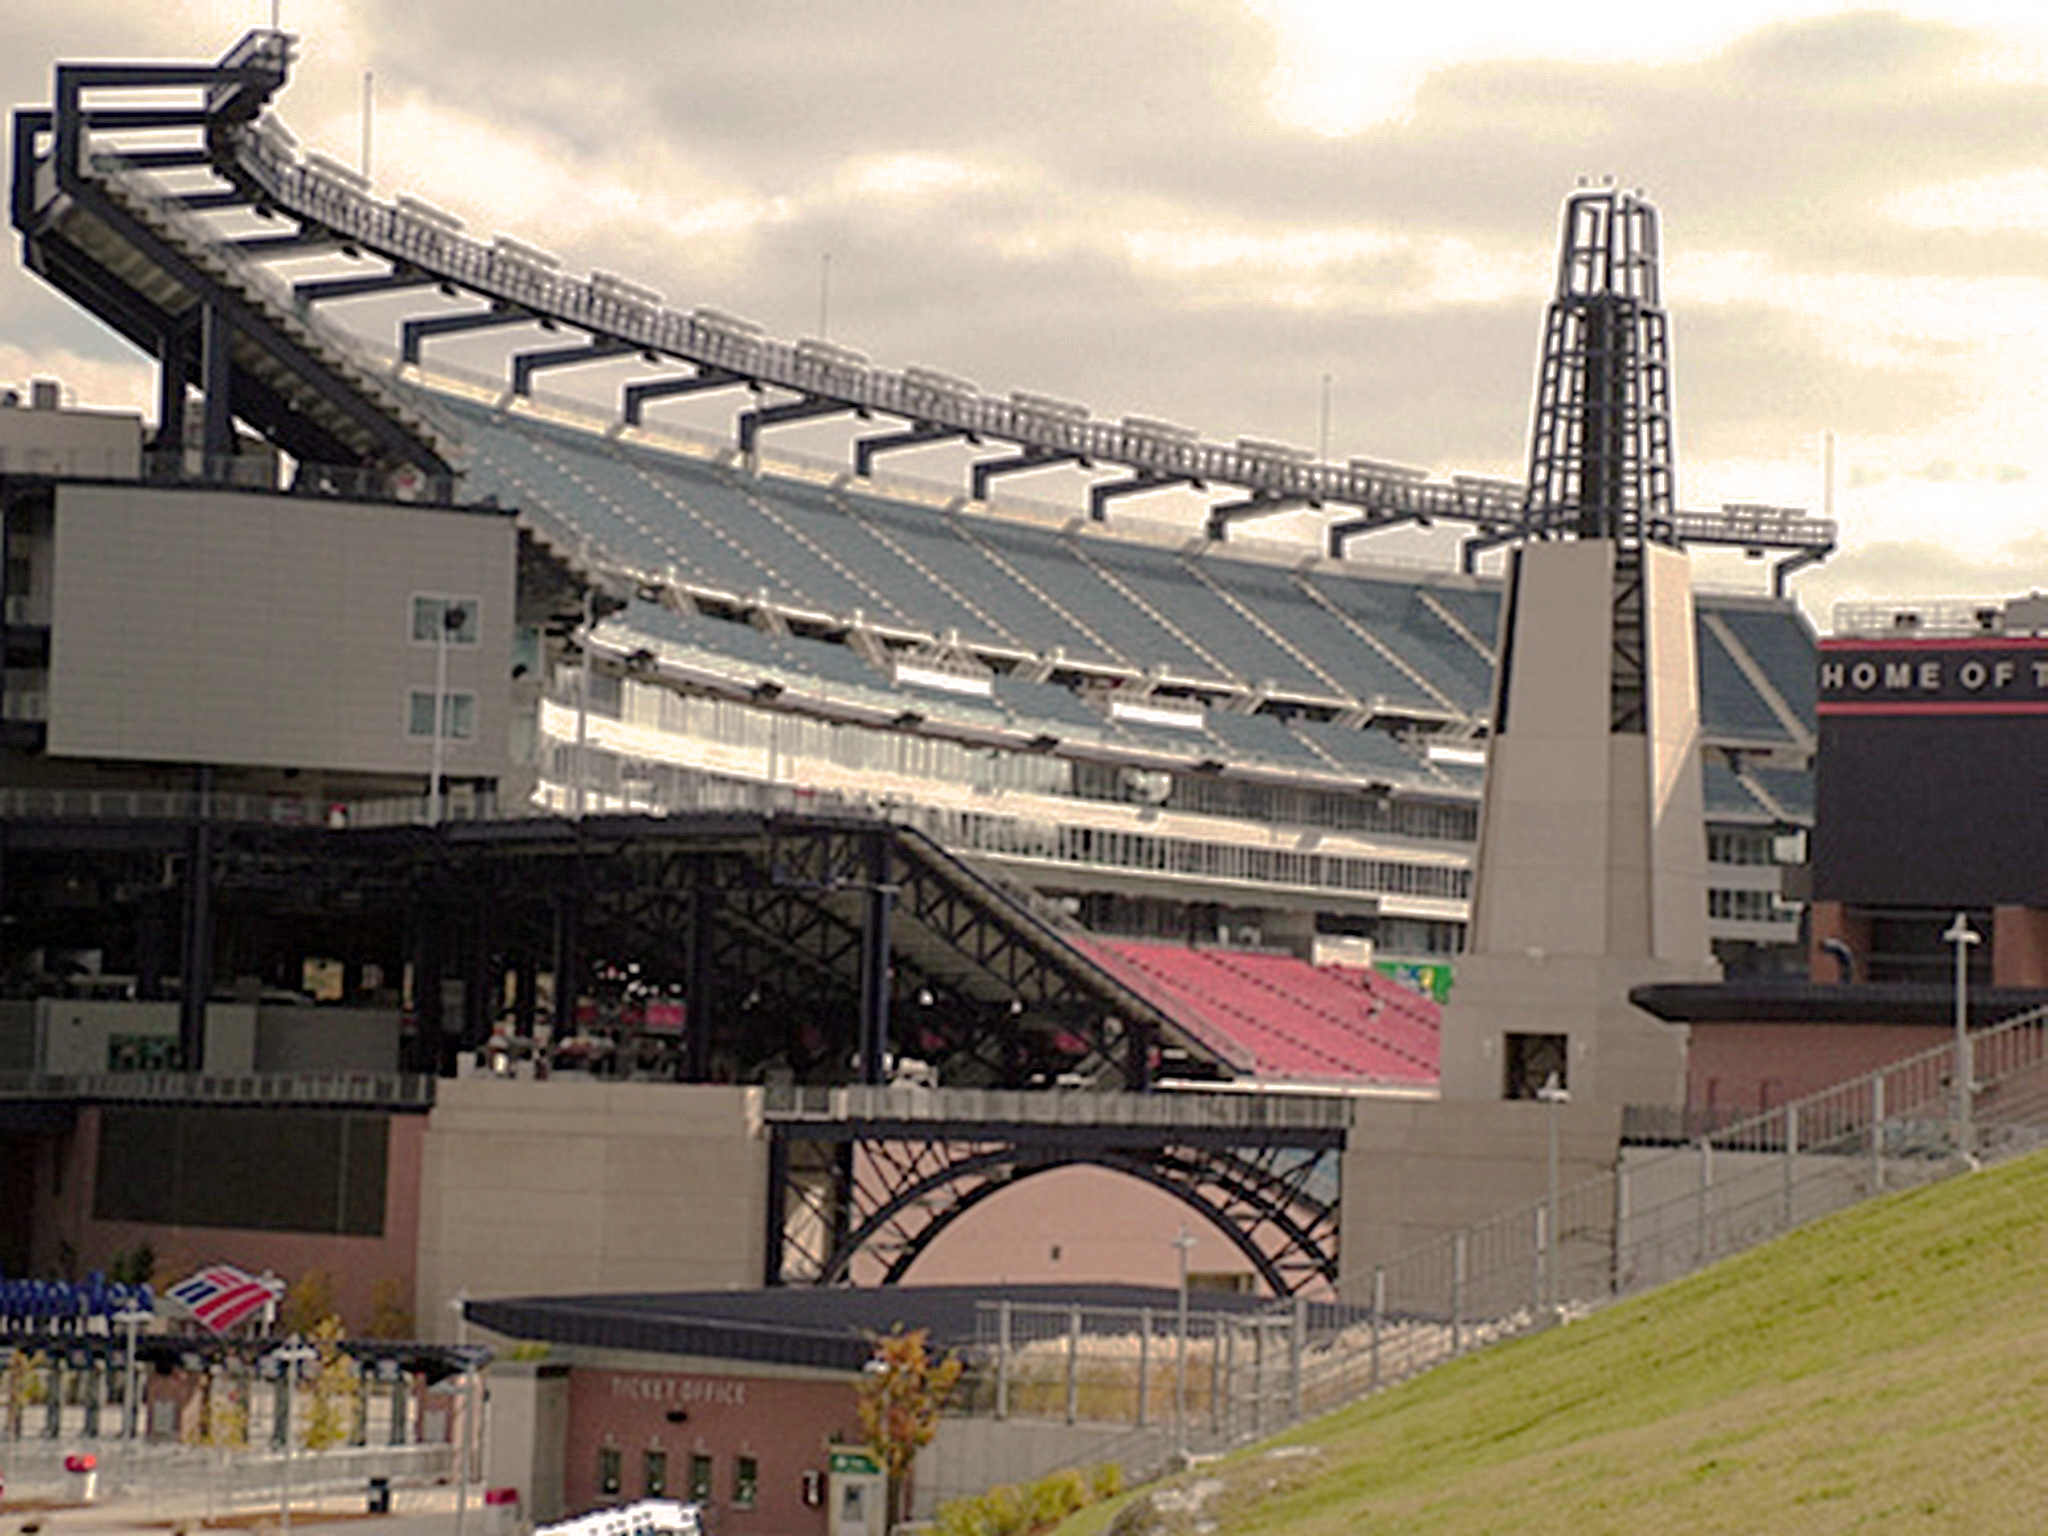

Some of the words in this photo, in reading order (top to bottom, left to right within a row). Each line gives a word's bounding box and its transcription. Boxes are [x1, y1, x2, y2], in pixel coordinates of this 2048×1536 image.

[1821, 661, 1941, 690] HOME
[1960, 661, 2015, 690] OF
[611, 1375, 677, 1399] TICKET
[678, 1379, 746, 1405] OFFICE
